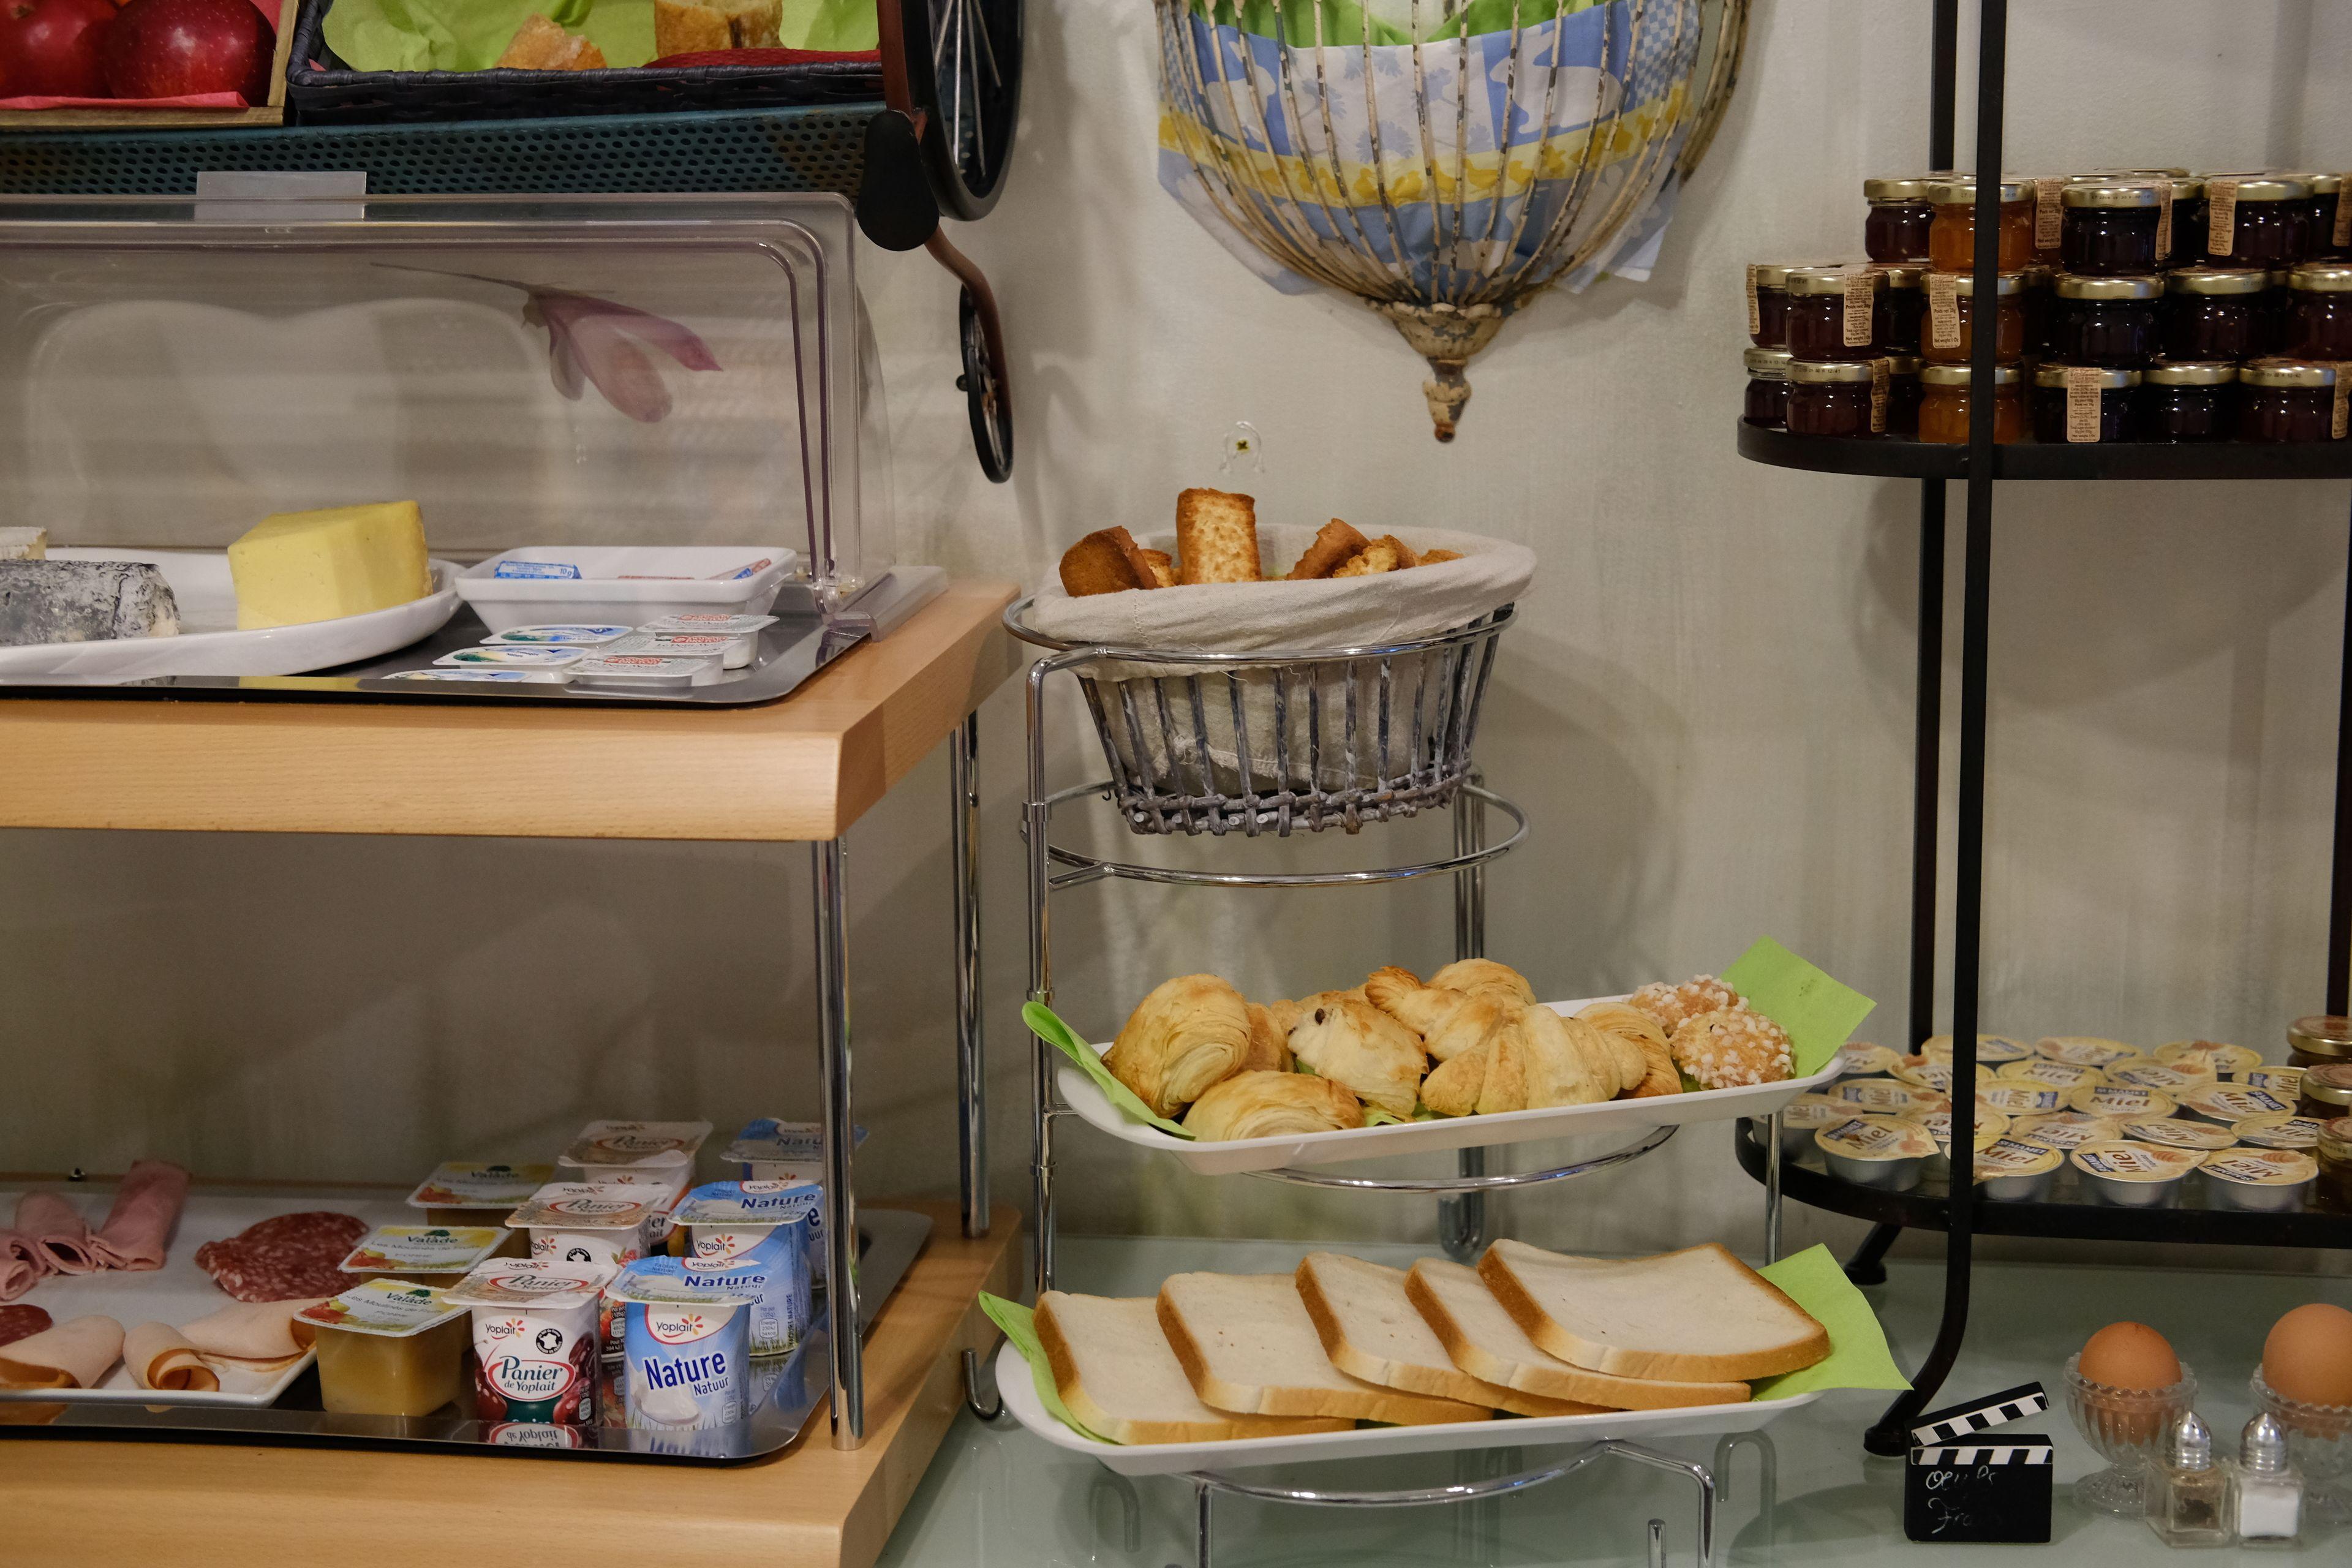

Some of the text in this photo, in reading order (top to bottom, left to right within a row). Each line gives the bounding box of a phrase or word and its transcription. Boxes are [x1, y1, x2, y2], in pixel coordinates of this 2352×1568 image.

[2090, 1096, 2150, 1107] Miel
[2217, 1091, 2266, 1113] Miel
[1846, 1126, 1893, 1150] Miel
[1975, 1145, 2039, 1164] Miel
[2105, 1150, 2148, 1172] Miel
[2220, 1159, 2283, 1177] Miel
[567, 1199, 631, 1211] Panier
[741, 1194, 816, 1209] Nature
[696, 1239, 726, 1251] Yoplait
[509, 1274, 578, 1287] Panier
[685, 1275, 766, 1287] Nature
[486, 1323, 516, 1335] Yoplait
[657, 1321, 693, 1333] Yoplait
[499, 1355, 563, 1381] Panier
[644, 1352, 726, 1390] Nature
[504, 1381, 556, 1393] de Yoplait
[693, 1377, 729, 1396] Natuur
